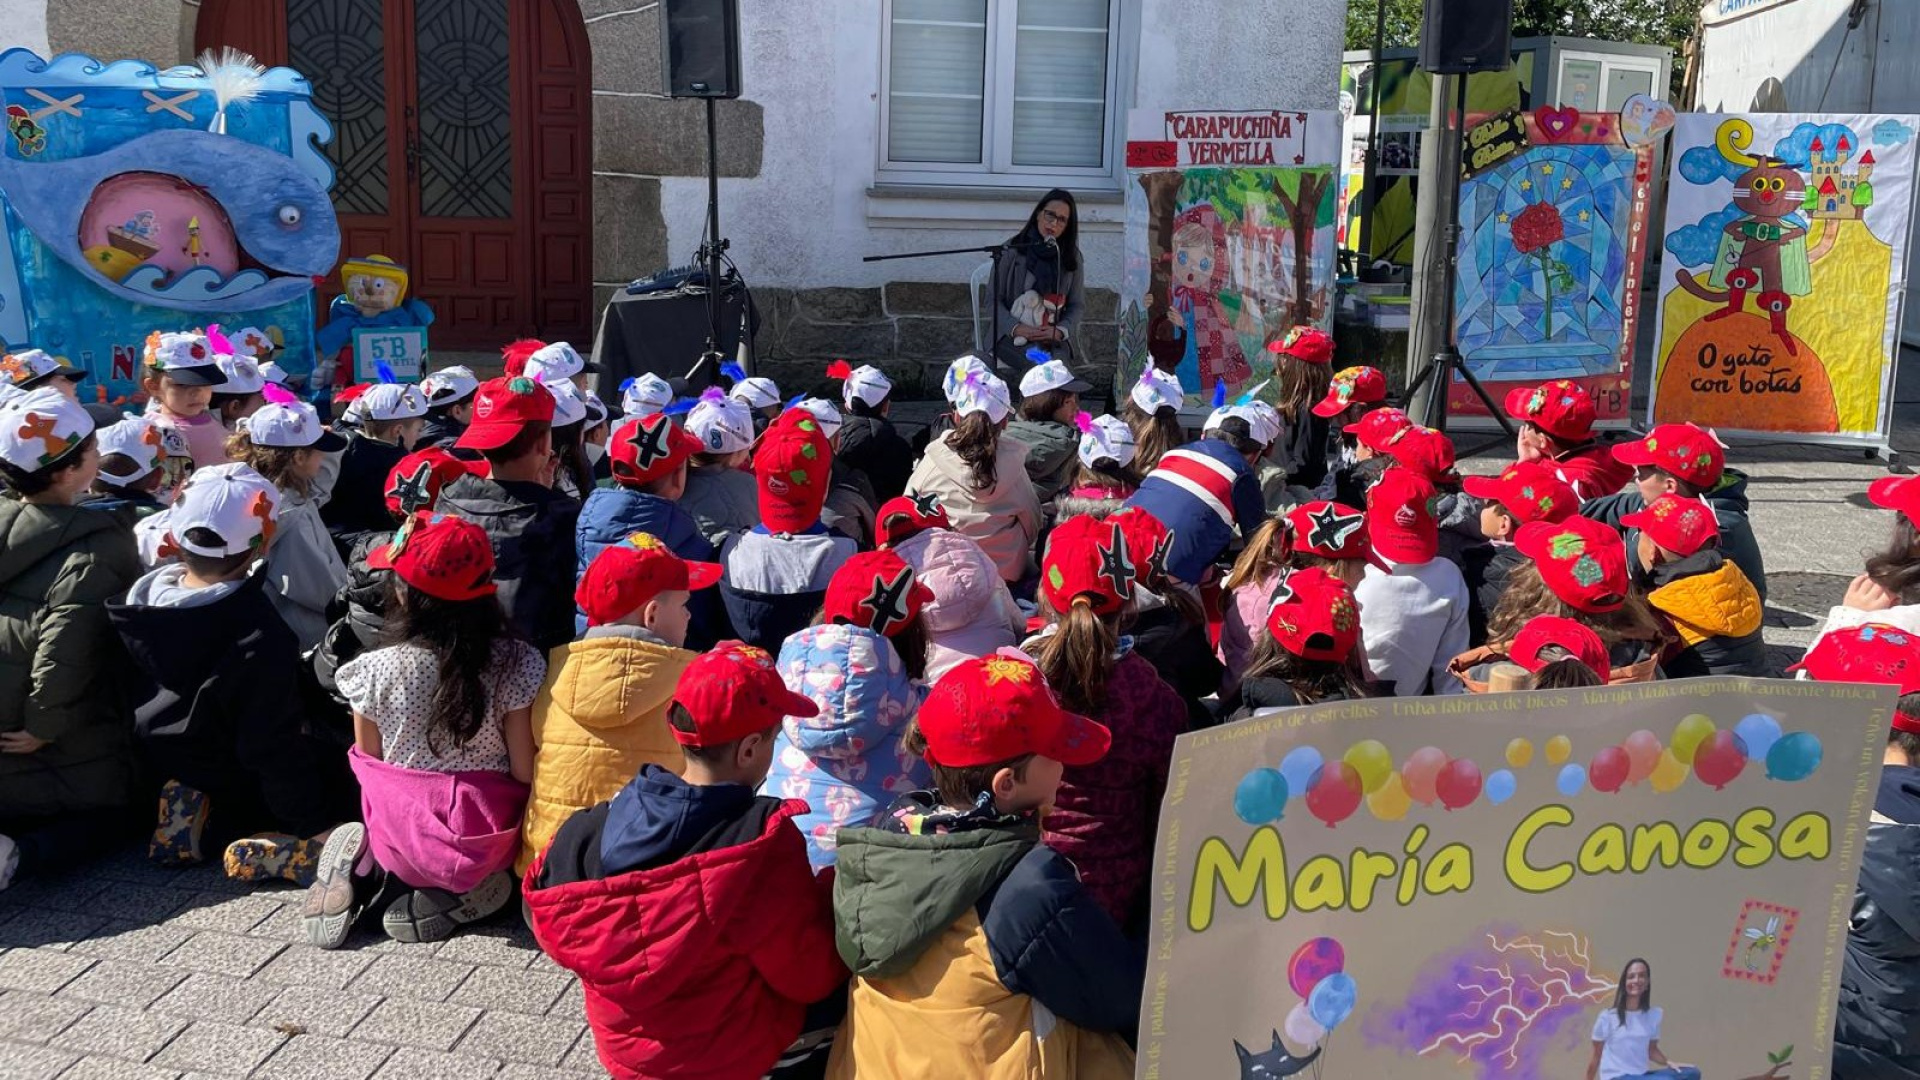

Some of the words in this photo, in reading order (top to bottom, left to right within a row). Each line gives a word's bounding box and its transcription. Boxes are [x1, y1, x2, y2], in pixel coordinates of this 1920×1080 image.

[1173, 112, 1292, 139] CARAPUCHIÑA
[1188, 142, 1276, 165] VERMELLA
[1698, 342, 1717, 369] O
[1721, 343, 1776, 376] gato
[1690, 376, 1733, 393] con
[1739, 367, 1803, 394] botas
[1393, 700, 1436, 716] Unha
[1503, 694, 1521, 711] de
[1527, 692, 1569, 709] bicos
[1191, 733, 1211, 748] La
[1214, 716, 1284, 742] cazadora
[1287, 711, 1306, 728] de
[1310, 702, 1379, 725] estrellas
[1861, 747, 1873, 766] un
[1171, 757, 1192, 807] Muriel
[1839, 822, 1859, 872] dentro
[1187, 823, 1474, 932] María
[1503, 804, 1831, 892] Canosa
[1160, 879, 1176, 902] de
[1157, 906, 1176, 961] Escola
[1151, 970, 1168, 1036] palabras
[1147, 1040, 1162, 1058] de
